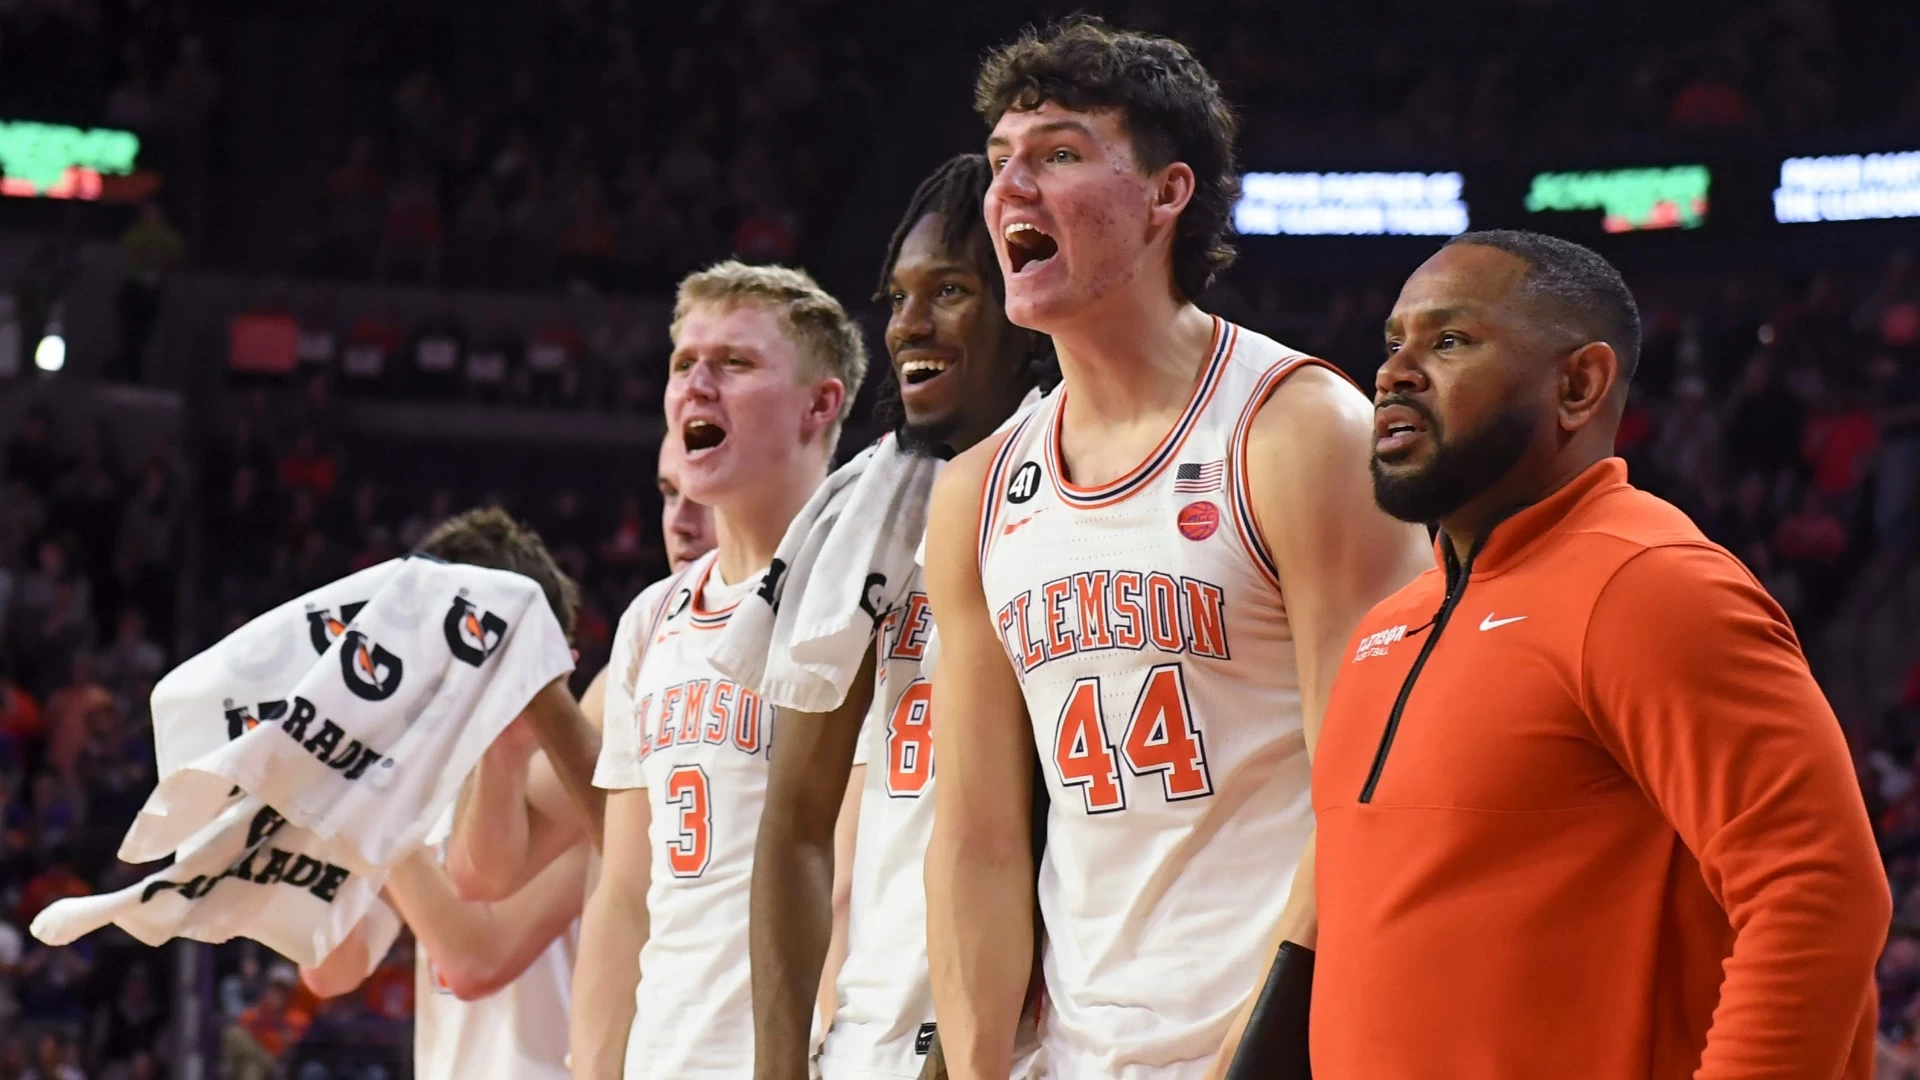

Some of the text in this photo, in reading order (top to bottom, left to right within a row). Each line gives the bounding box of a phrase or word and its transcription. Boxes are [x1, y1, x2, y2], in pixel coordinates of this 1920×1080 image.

[1008, 464, 1037, 498] 41
[340, 630, 404, 701] G
[443, 595, 508, 669] G
[997, 570, 1231, 685] CLEMSON
[632, 678, 775, 764] LEMSO
[886, 676, 936, 798] 8
[1052, 661, 1215, 816] 44
[665, 763, 713, 879] 3
